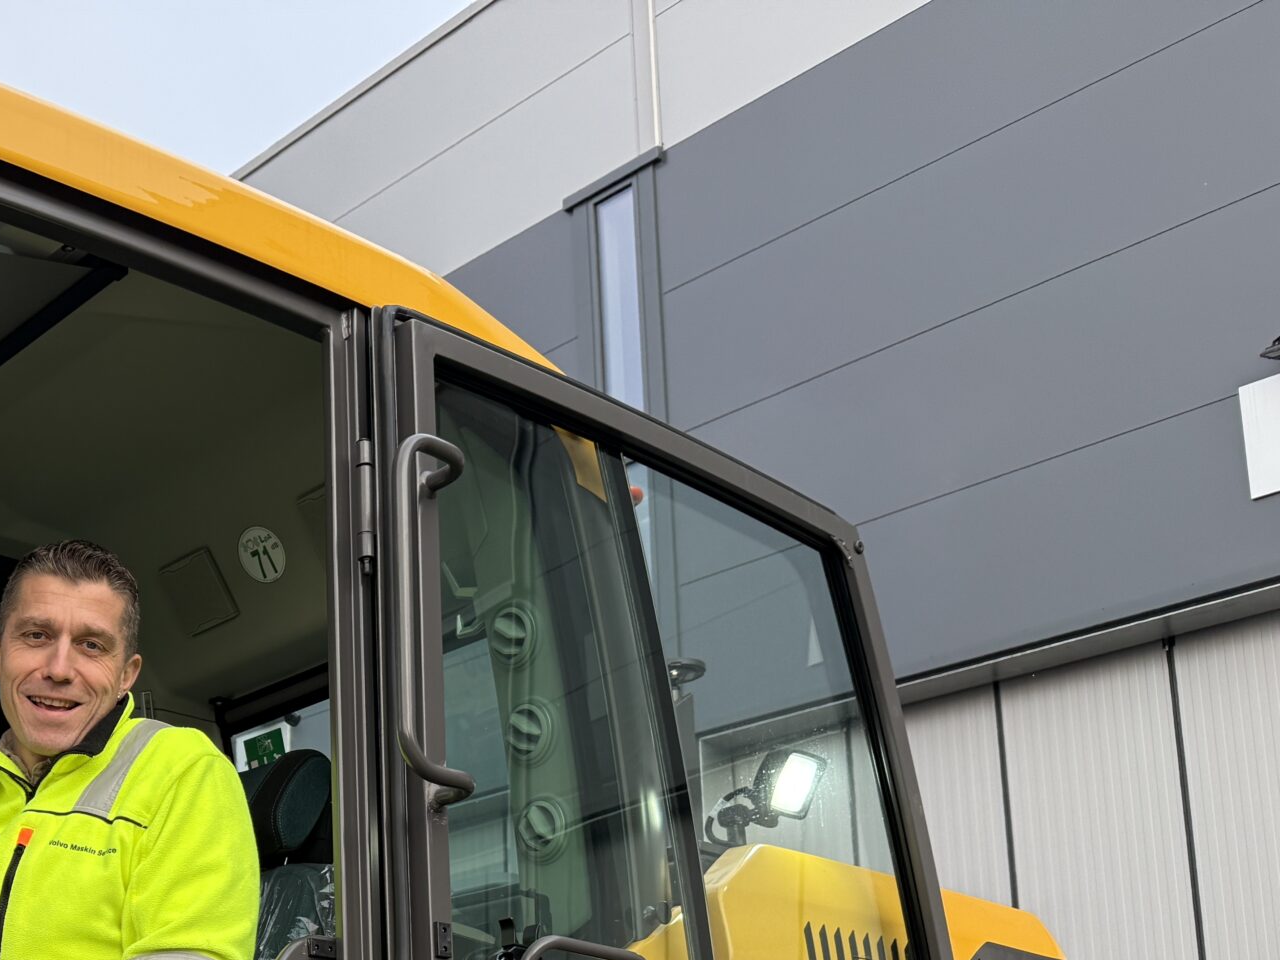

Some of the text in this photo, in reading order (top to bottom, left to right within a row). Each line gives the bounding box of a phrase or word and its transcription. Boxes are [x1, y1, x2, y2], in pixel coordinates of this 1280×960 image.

[250, 545, 278, 578] 71
[70, 843, 96, 855] Maskin
[97, 848, 117, 857] Seice
